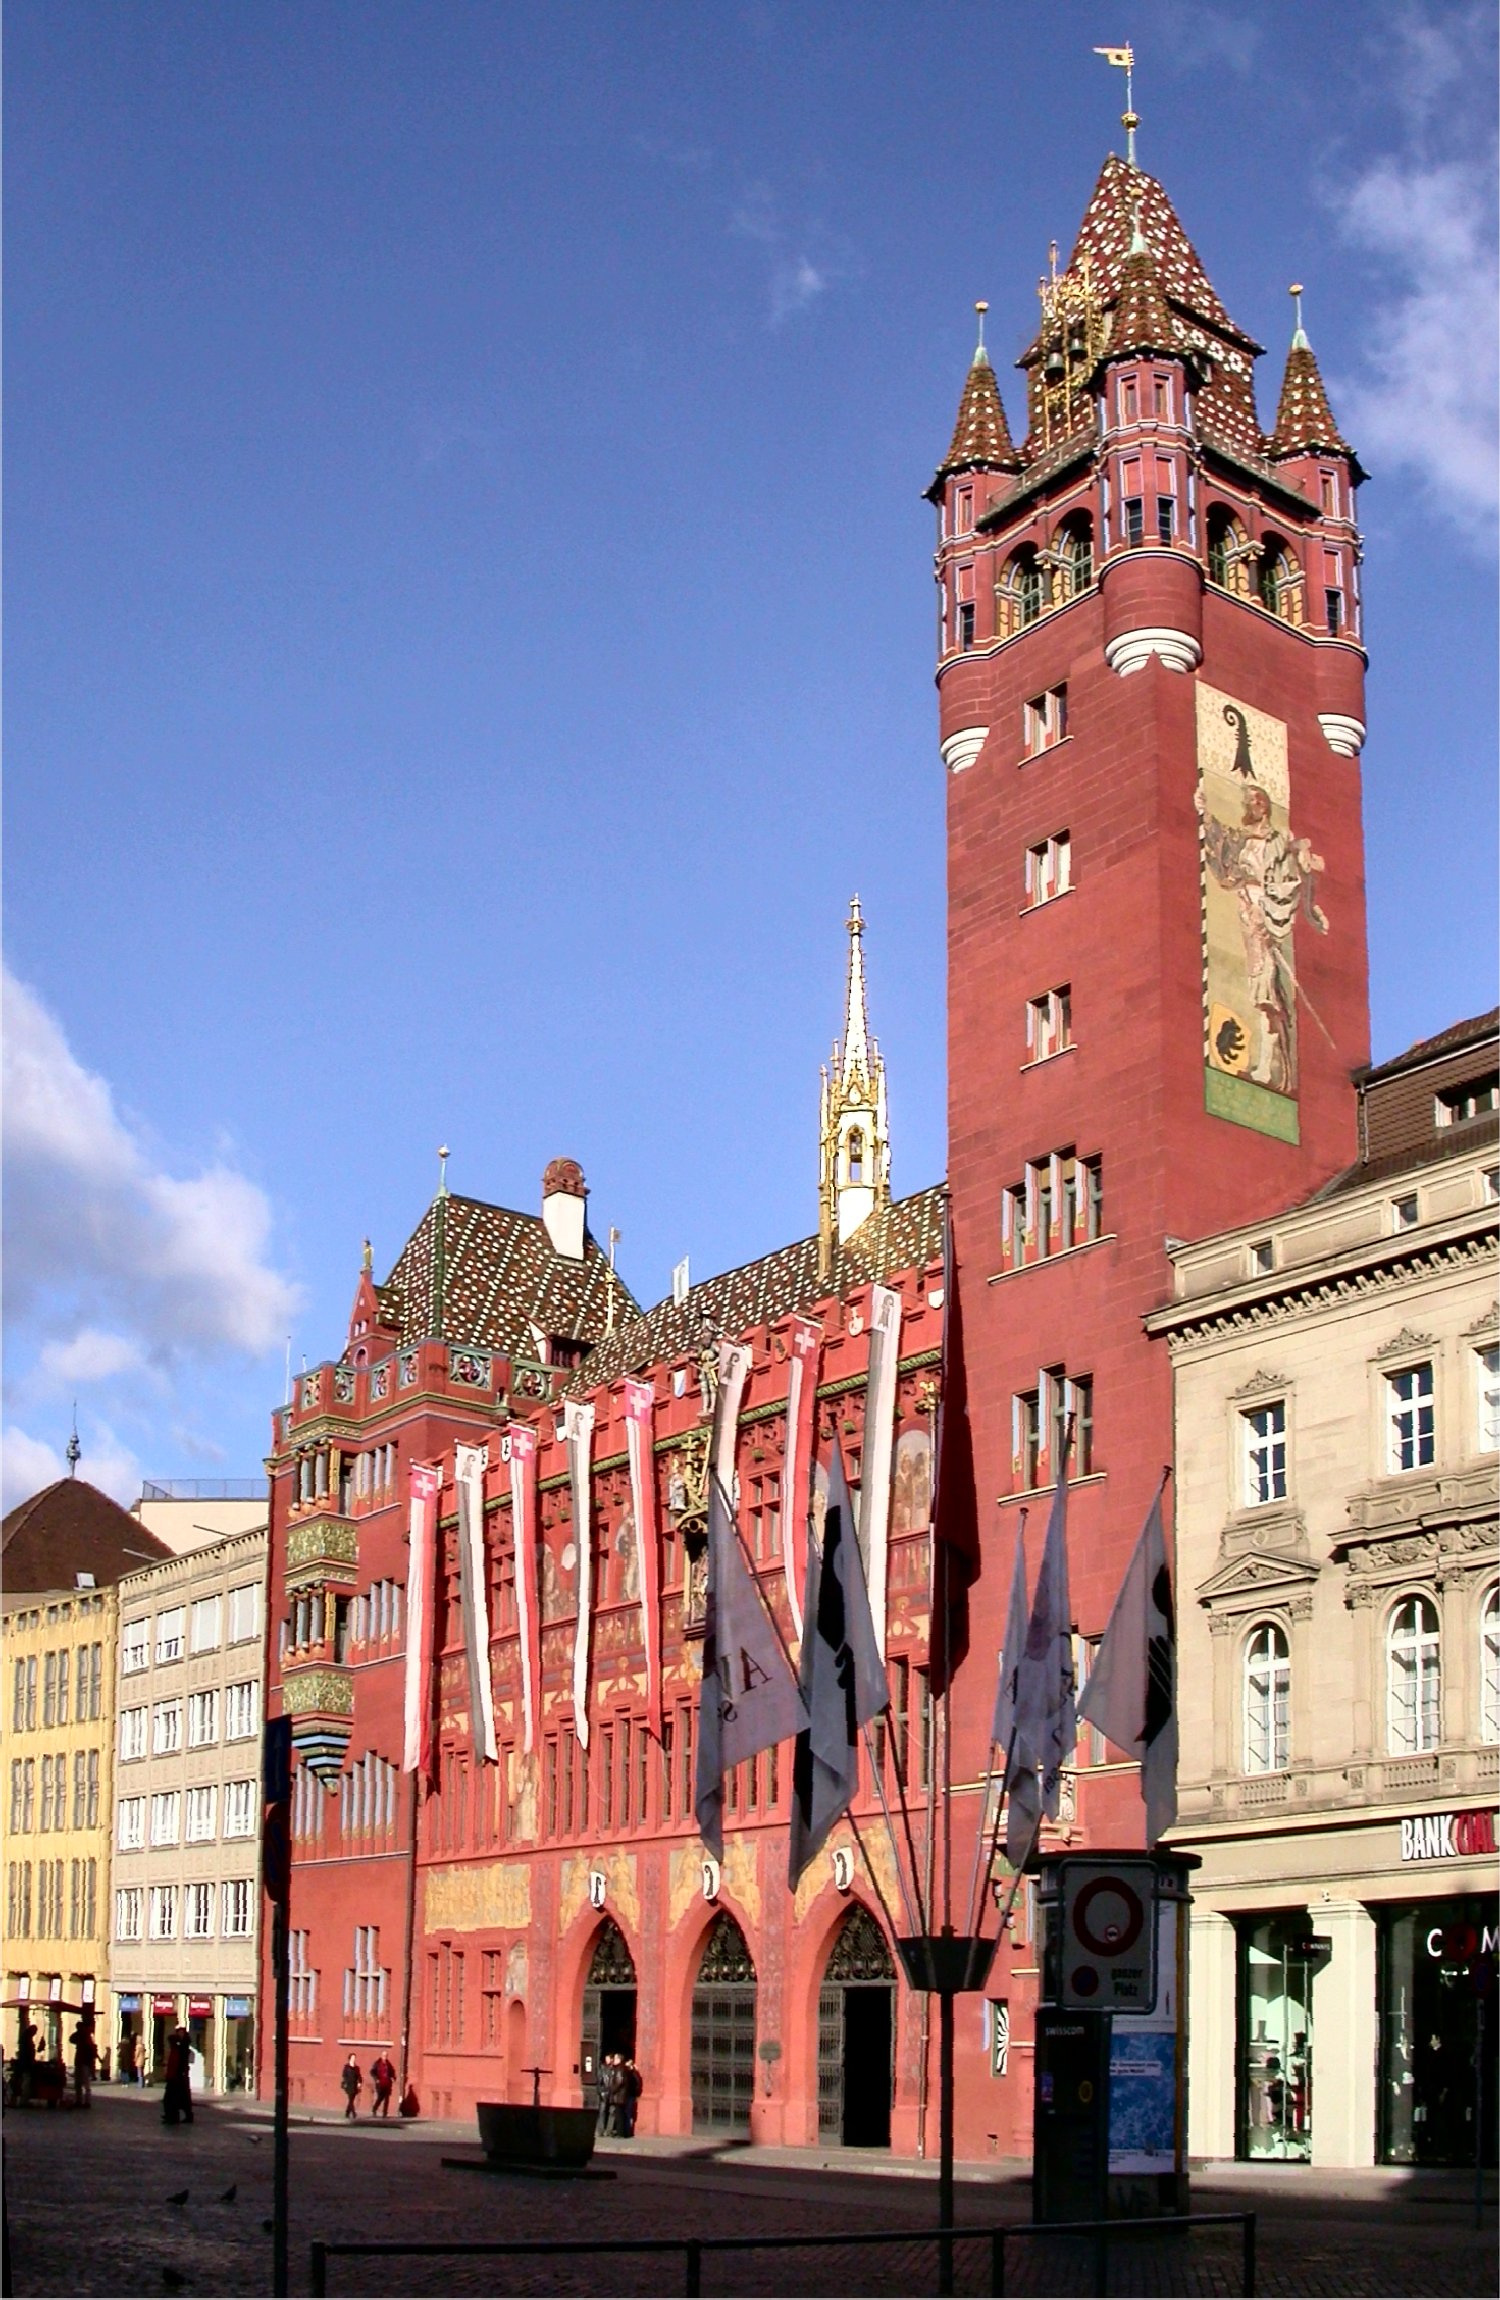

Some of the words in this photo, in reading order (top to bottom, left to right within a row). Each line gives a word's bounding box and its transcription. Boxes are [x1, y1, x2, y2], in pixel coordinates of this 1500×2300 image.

[1401, 1814, 1456, 1861] BANK
[1114, 1981, 1138, 1996] Platz
[1044, 2023, 1085, 2036] swisscom
